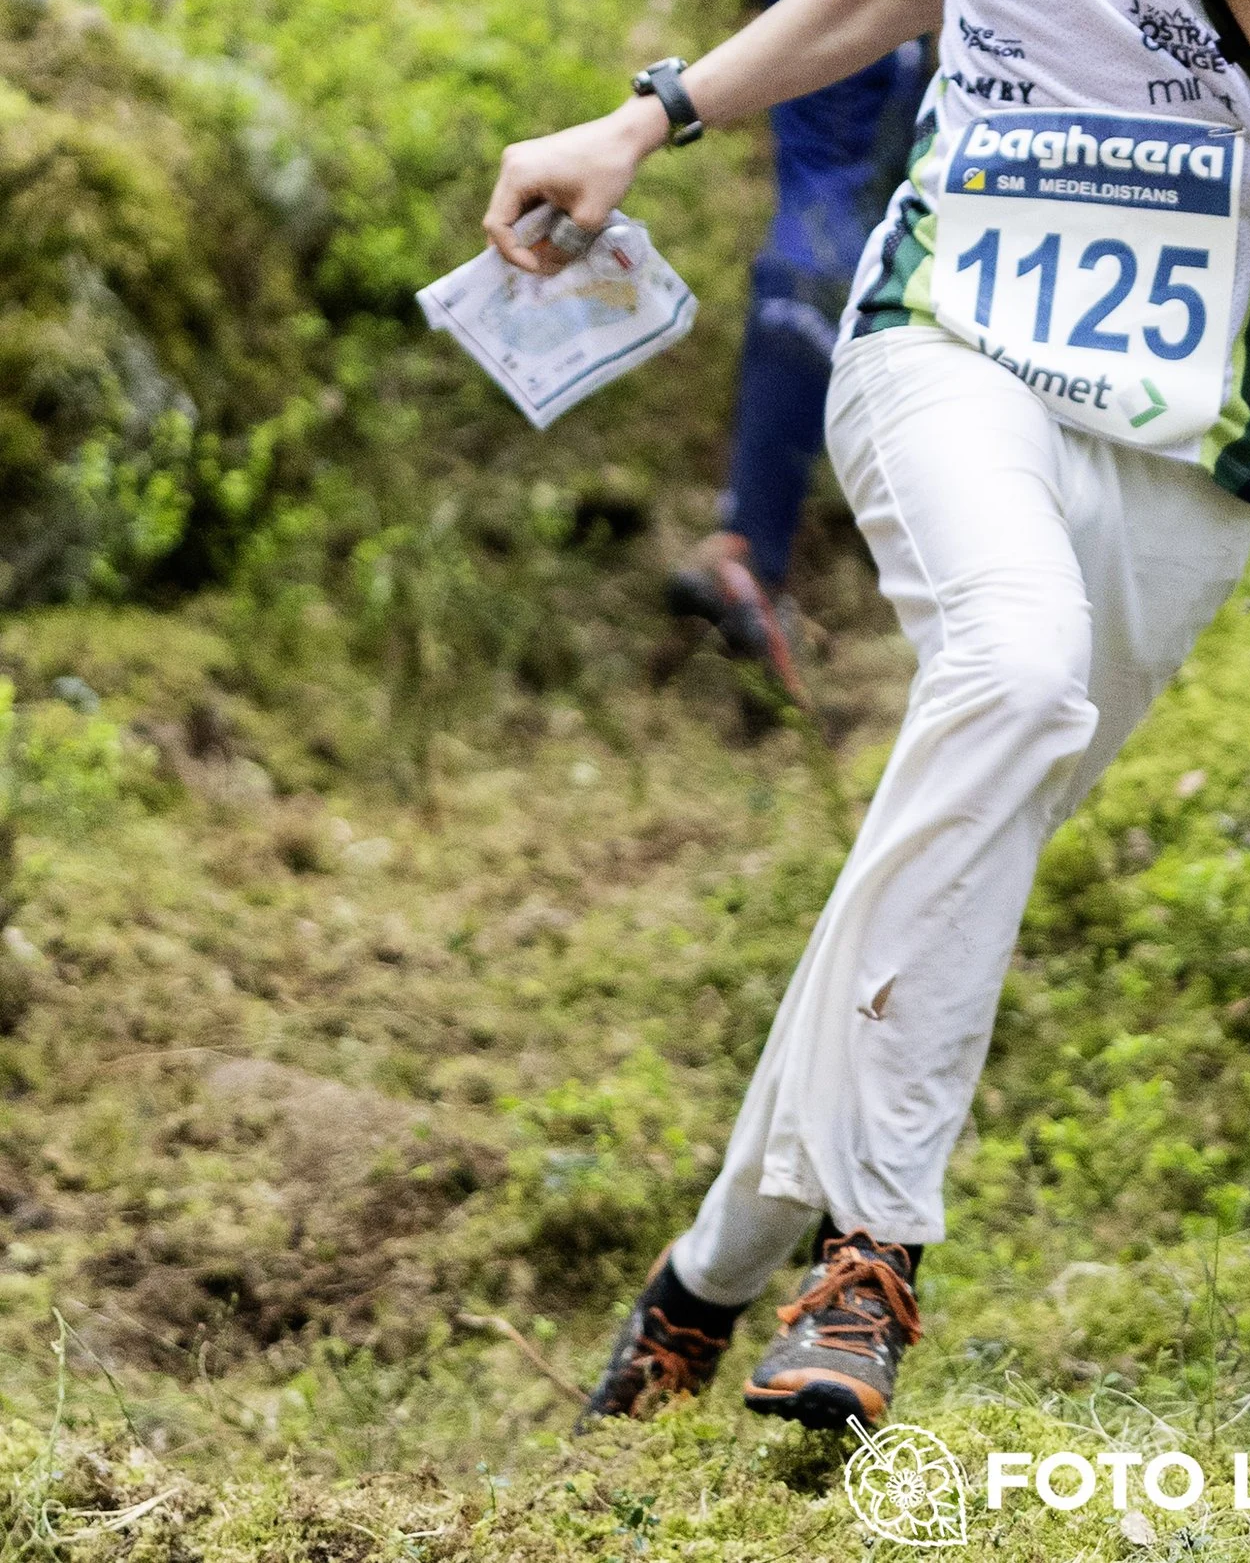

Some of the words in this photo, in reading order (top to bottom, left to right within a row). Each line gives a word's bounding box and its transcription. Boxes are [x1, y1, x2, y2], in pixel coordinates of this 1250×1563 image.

[963, 122, 1224, 179] bagheera
[997, 174, 1026, 191] SM
[1039, 175, 1179, 205] MEDELDISTANS
[956, 228, 1208, 361] 1125
